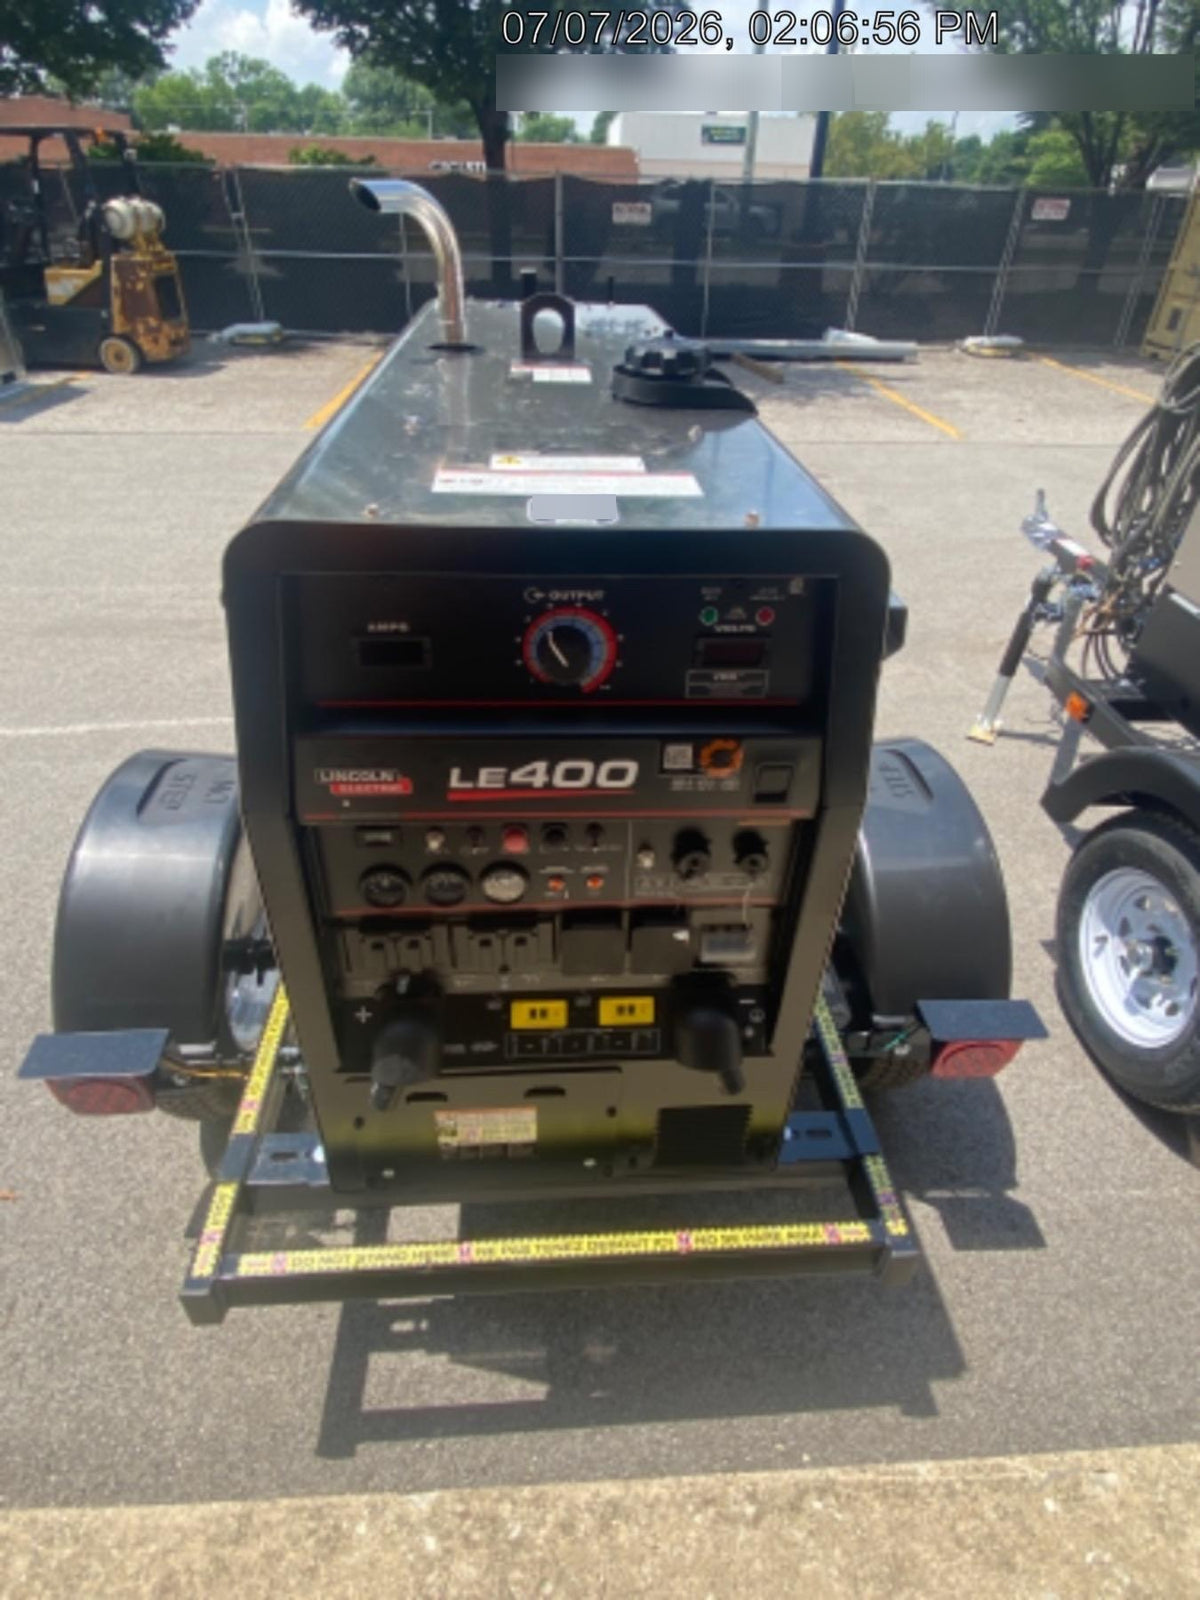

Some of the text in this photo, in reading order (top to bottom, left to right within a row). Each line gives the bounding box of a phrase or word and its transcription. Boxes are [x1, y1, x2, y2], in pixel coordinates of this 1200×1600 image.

[549, 589, 606, 601] OUTPUT
[367, 621, 410, 633] AMPS
[320, 769, 395, 782] LINCOLN
[450, 761, 639, 788] LE400
[319, 1254, 350, 1267] NOT
